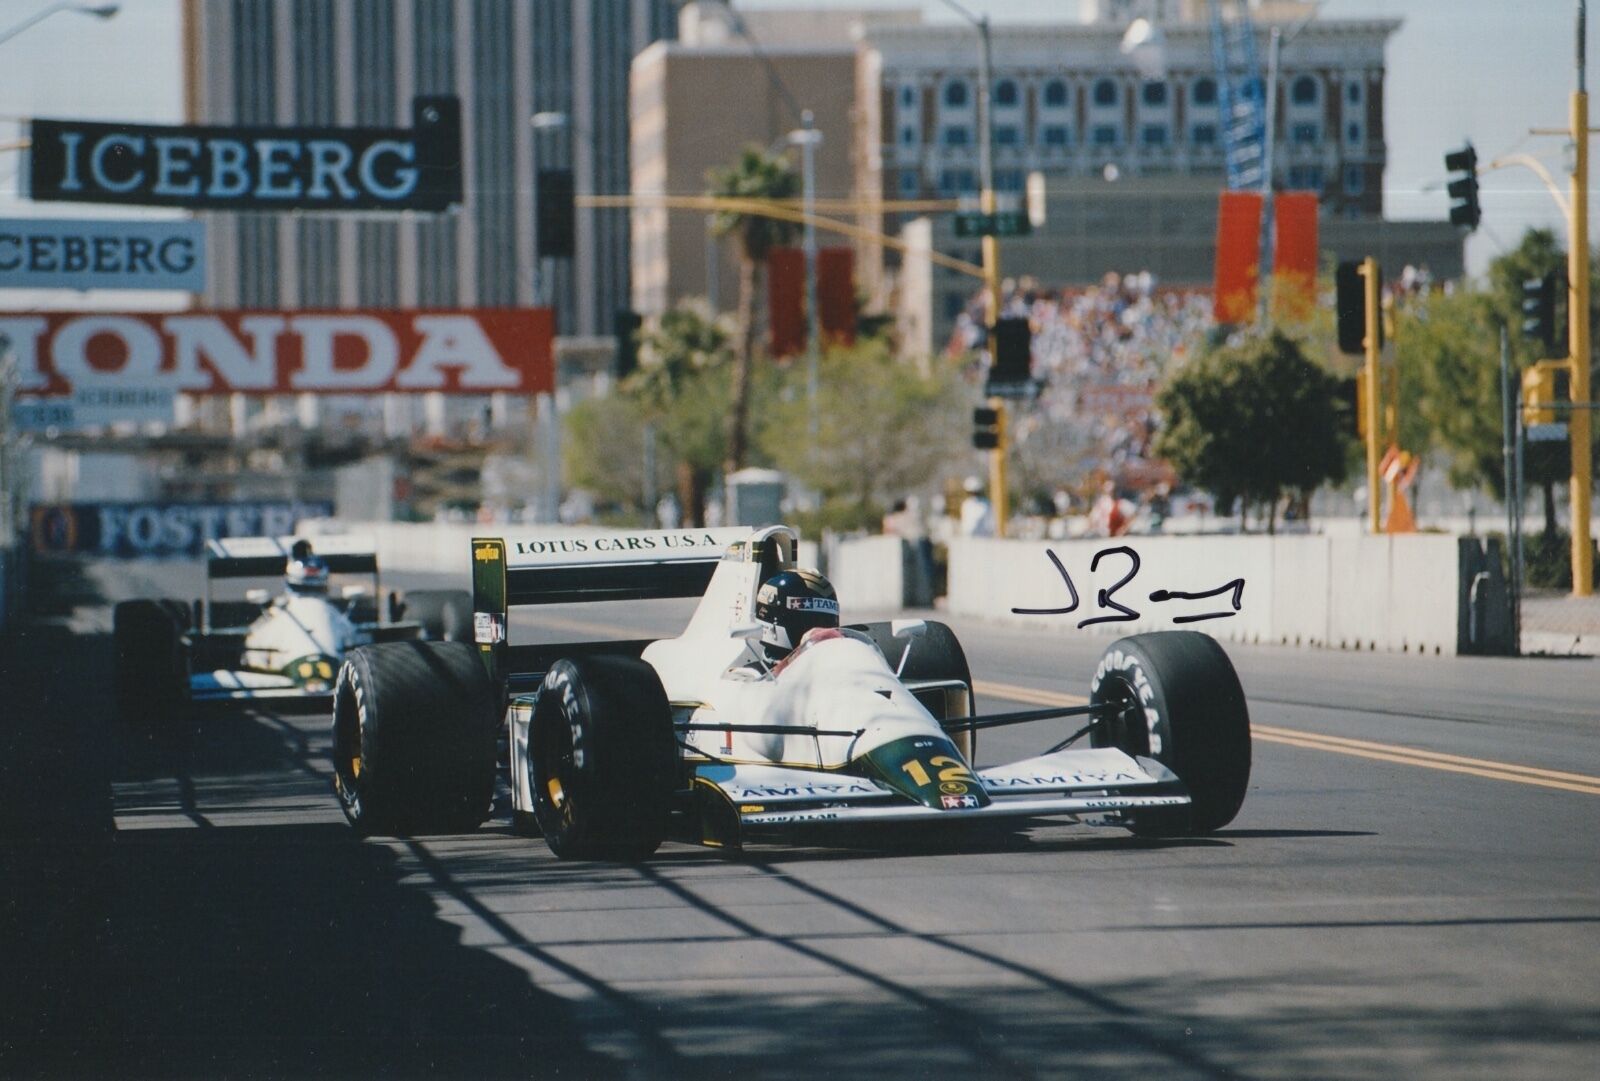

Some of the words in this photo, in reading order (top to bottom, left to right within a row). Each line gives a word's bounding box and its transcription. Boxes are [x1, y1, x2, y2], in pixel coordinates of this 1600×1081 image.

[60, 132, 419, 200] ICEBERG
[517, 540, 588, 555] LOTUS
[595, 536, 656, 551] CARS
[902, 755, 978, 787] 12
